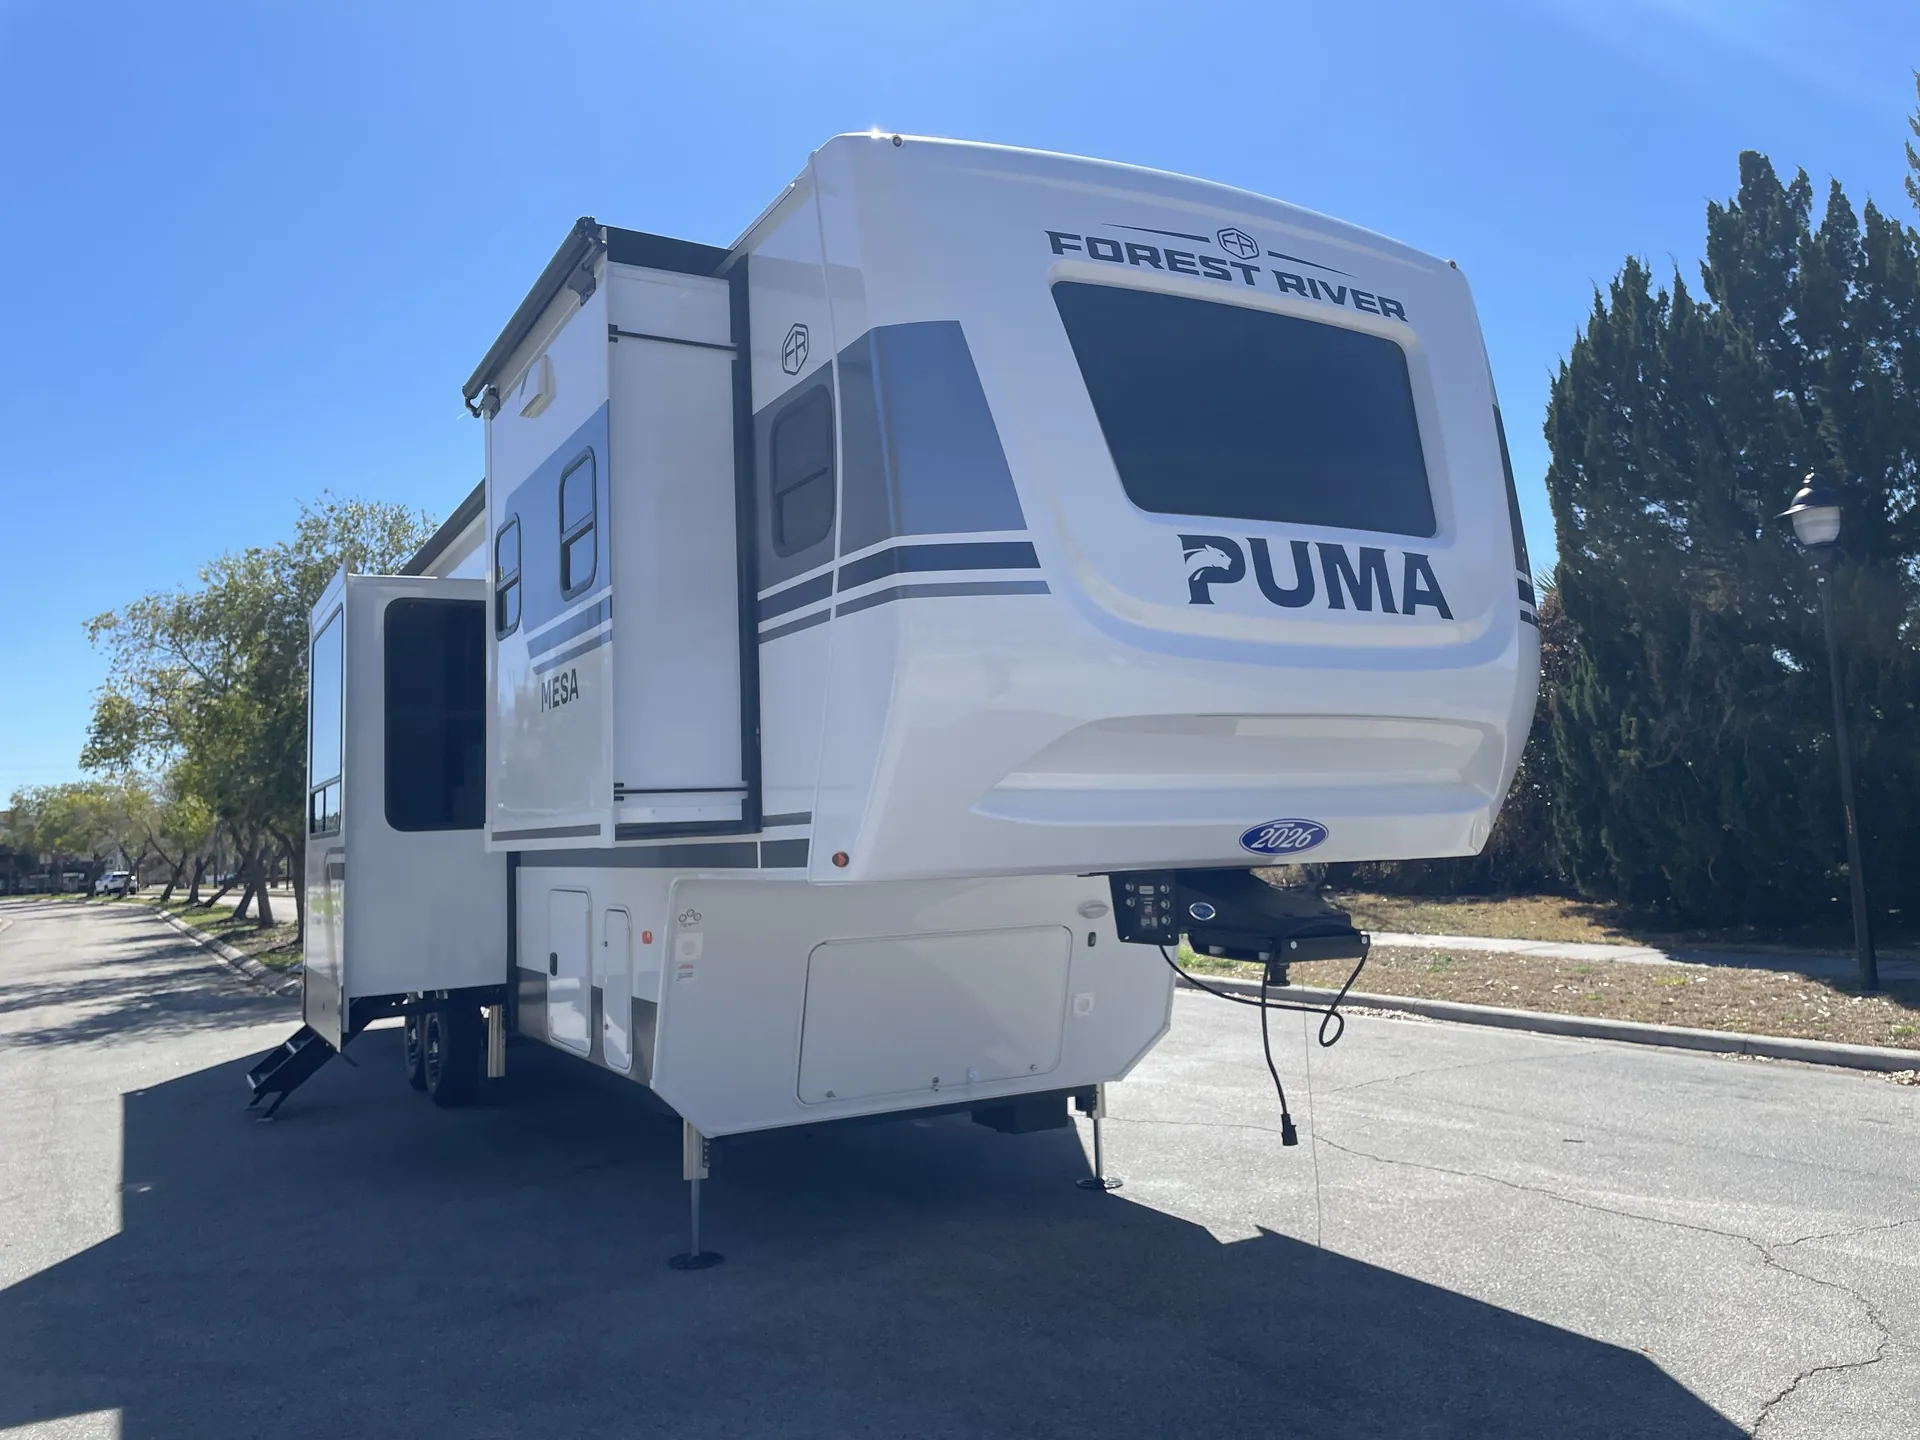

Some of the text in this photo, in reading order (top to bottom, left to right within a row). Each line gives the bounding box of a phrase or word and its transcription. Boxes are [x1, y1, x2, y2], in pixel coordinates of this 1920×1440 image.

[1045, 230, 1408, 322] FOREST RIVER
[1177, 534, 1454, 620] PUMA
[541, 668, 579, 713] MESA
[1251, 827, 1319, 848] 2026
